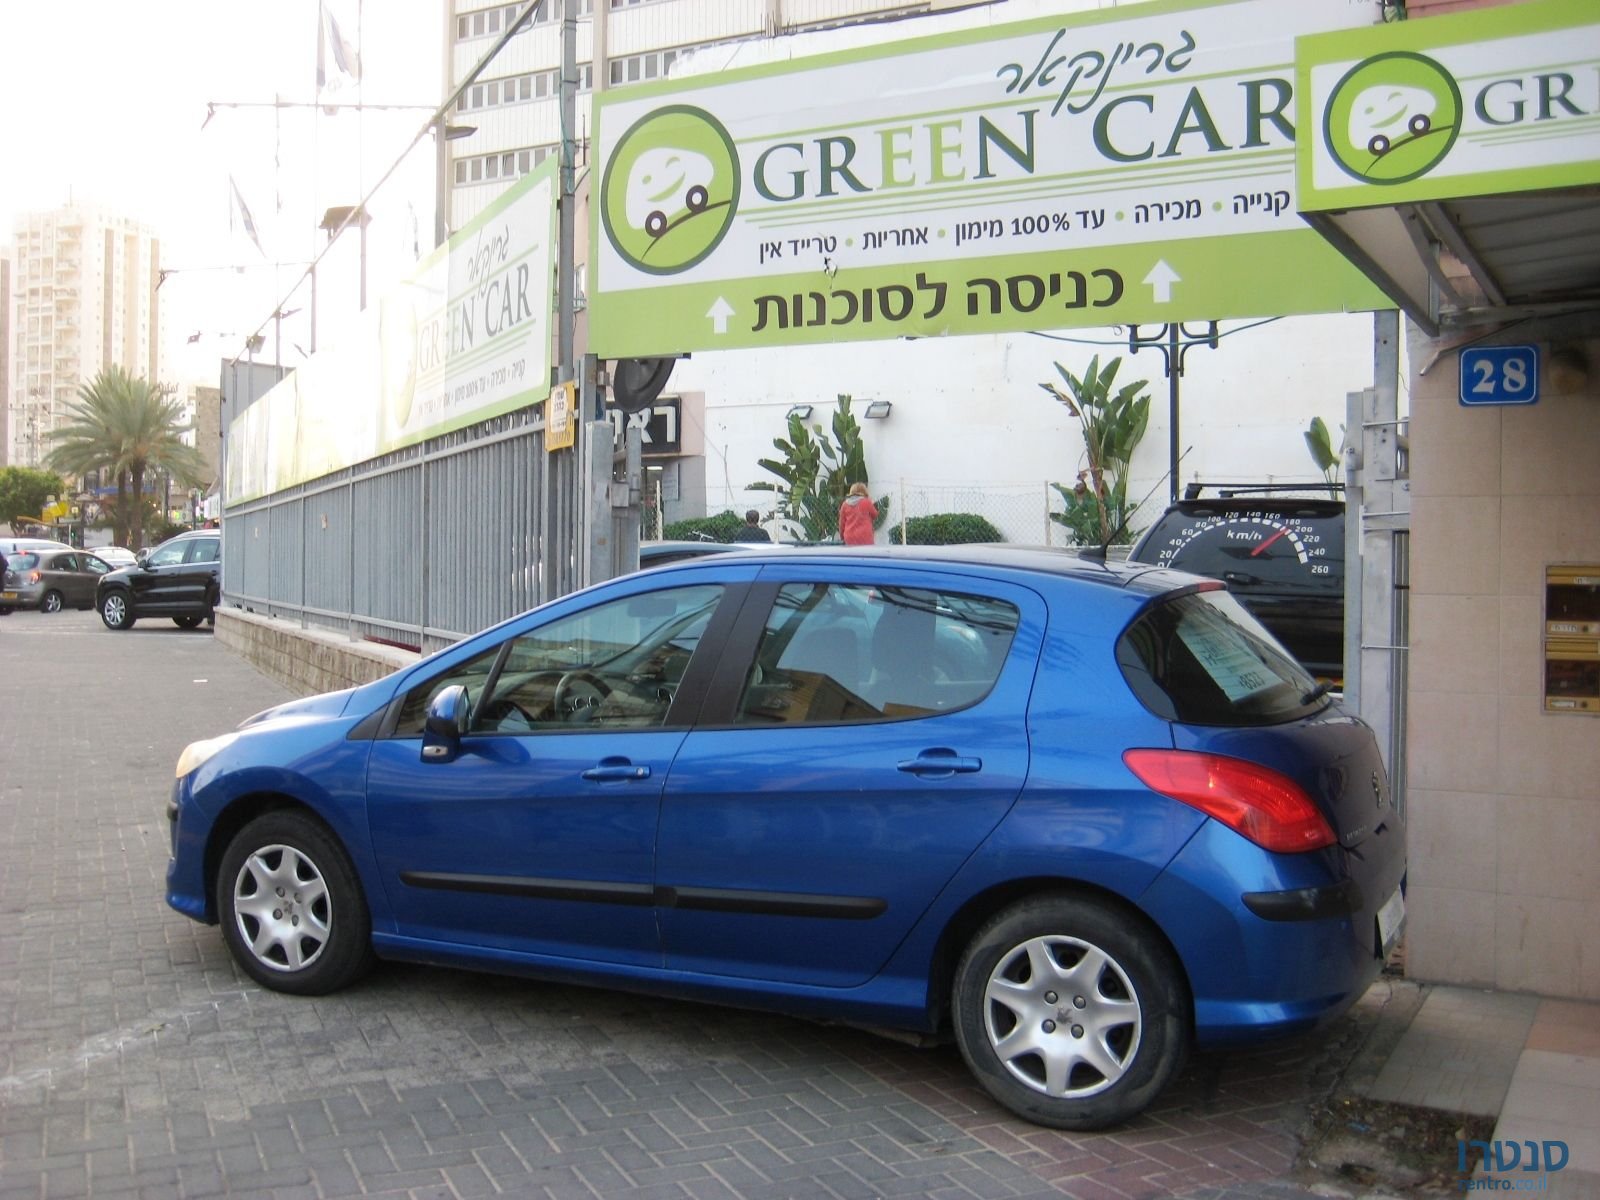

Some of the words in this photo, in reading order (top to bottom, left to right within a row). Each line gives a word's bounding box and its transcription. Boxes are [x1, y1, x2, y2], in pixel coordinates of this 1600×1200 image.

[753, 108, 1040, 202] GREEN
[1092, 78, 1295, 163] CAR
[1134, 199, 1202, 224] מכירה
[1232, 190, 1291, 216] קנייה
[1011, 213, 1070, 236] 100%
[1075, 208, 1106, 230] עד
[862, 226, 929, 250] אחריות
[955, 217, 1004, 246] מימון
[759, 241, 783, 264] אין
[787, 235, 838, 256] טרייד
[485, 263, 532, 337] CAR
[751, 272, 948, 332] לסוכנות
[966, 268, 1124, 315] כניסה
[1472, 358, 1527, 393] 28
[1225, 511, 1239, 519] 120
[1264, 512, 1281, 520] 160
[1169, 538, 1182, 546] 40
[1181, 528, 1194, 536] 60
[1227, 529, 1262, 540] km/h
[1302, 534, 1320, 543] 220
[1159, 550, 1172, 559] 20
[1308, 547, 1326, 557] 240
[1311, 564, 1329, 574] 260
